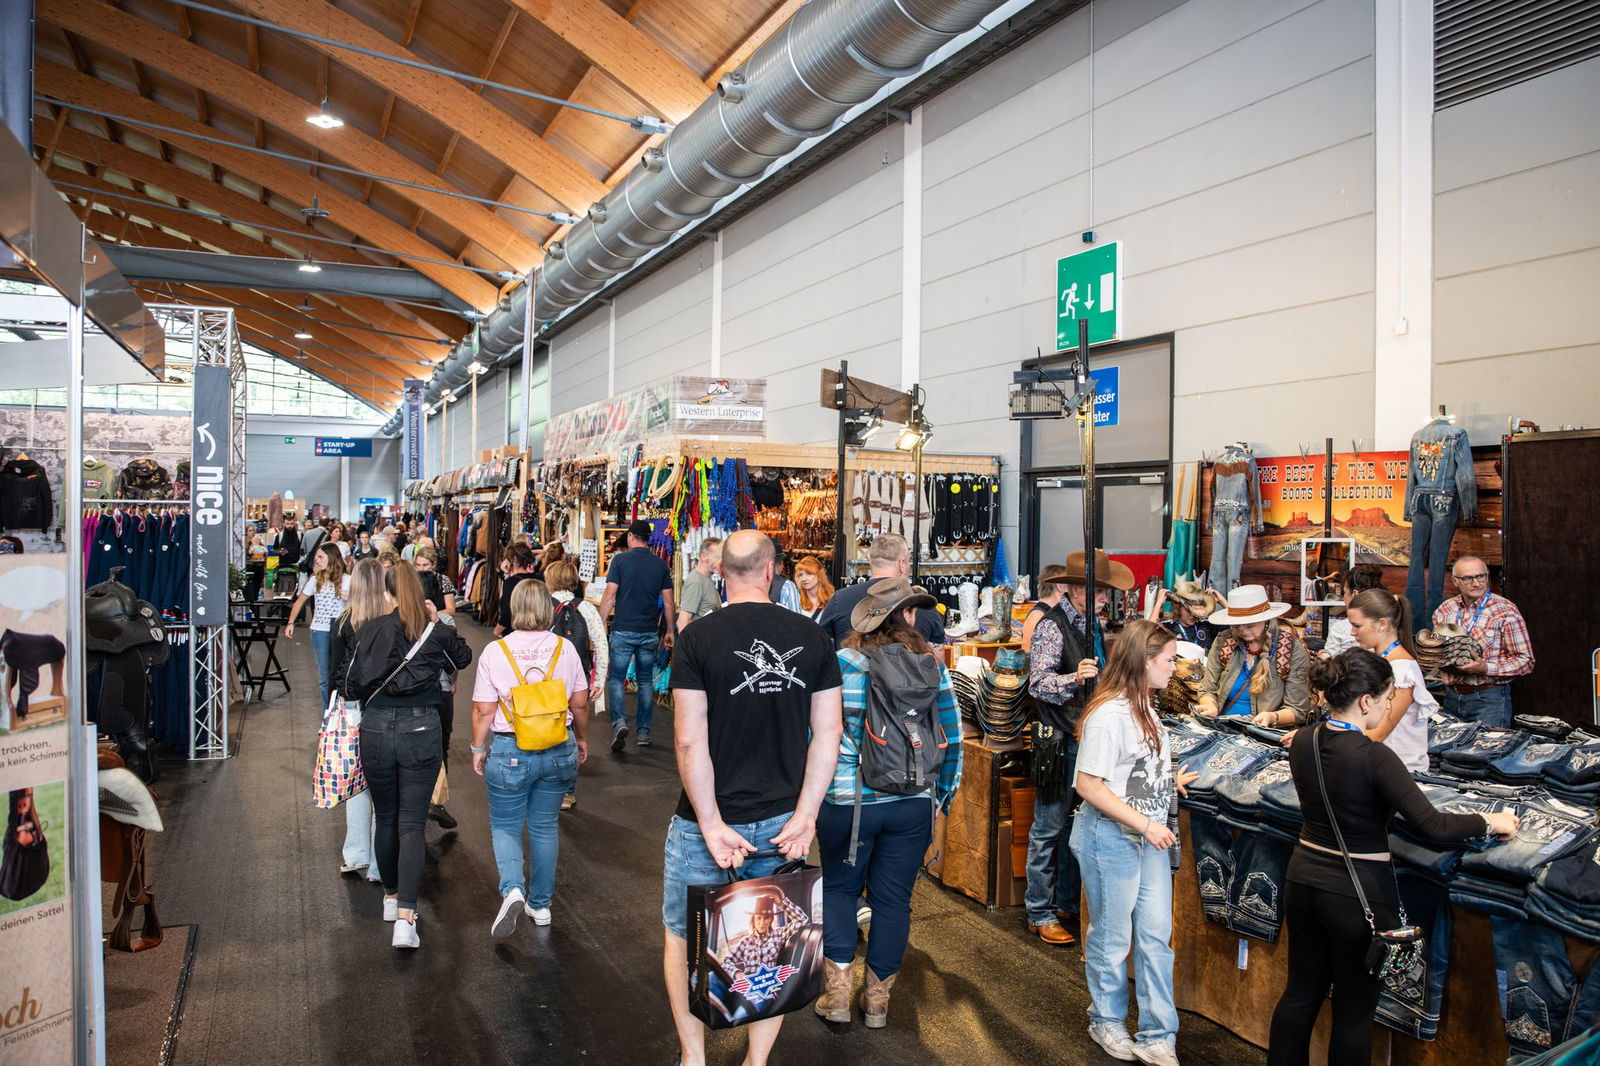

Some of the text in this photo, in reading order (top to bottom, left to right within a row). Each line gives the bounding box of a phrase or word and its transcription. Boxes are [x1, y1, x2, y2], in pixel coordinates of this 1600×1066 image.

[680, 405, 760, 418] Western Enterprise
[410, 410, 419, 478] Westernwelt.com
[1285, 464, 1316, 483] BEST
[1348, 461, 1376, 481] THE
[195, 466, 224, 526] nice
[1282, 484, 1393, 500] BOOTS CLLECTION
[193, 533, 209, 601] made with love
[1, 740, 52, 756] trocknen.
[7, 756, 28, 768] kein
[0, 903, 65, 931] deinen Sattel
